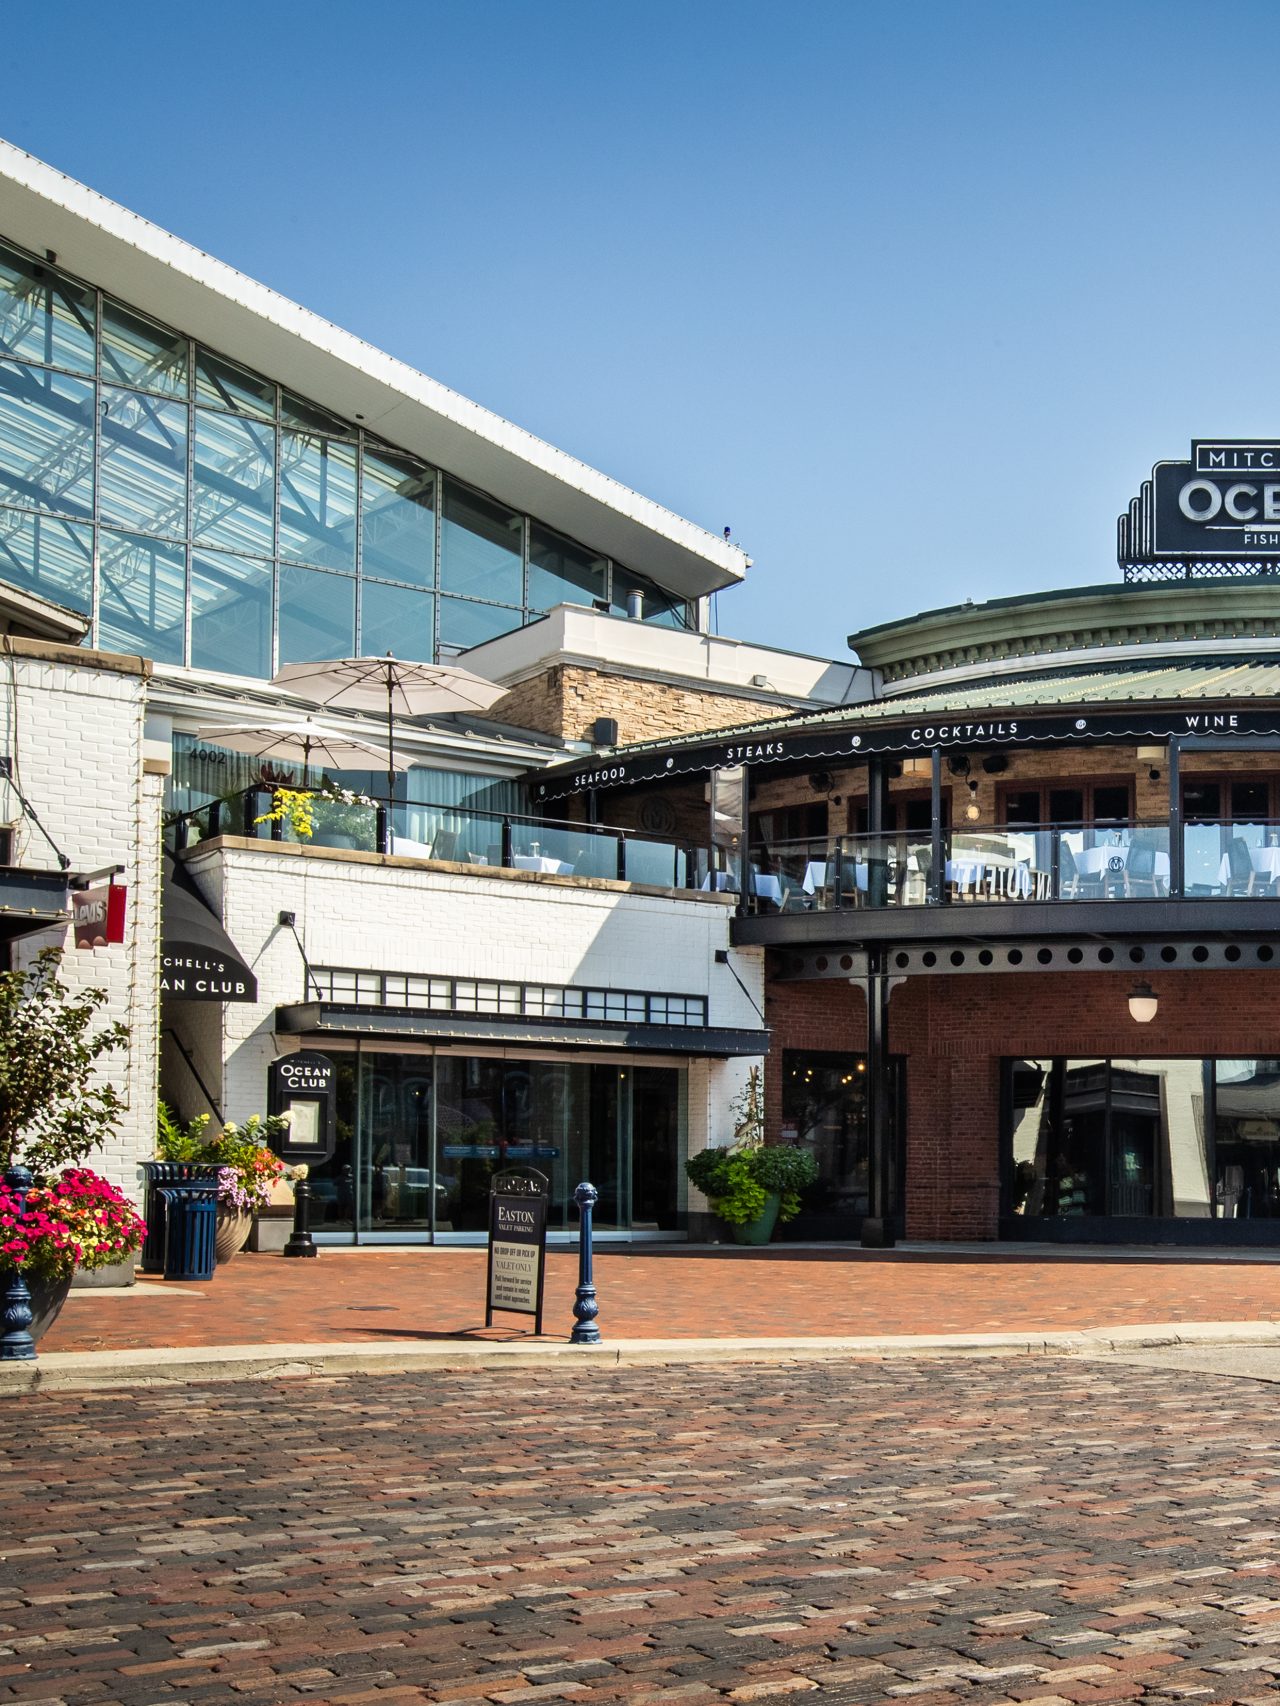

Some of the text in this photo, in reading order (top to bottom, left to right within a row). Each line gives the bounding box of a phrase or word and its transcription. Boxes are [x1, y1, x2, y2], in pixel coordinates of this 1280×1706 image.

[1244, 534, 1279, 545] FISH
[1185, 715, 1238, 728] WINE
[911, 722, 1018, 740] COCKTAILS
[190, 748, 226, 764] 4002
[726, 742, 783, 759] STEAKS
[574, 767, 625, 786] SEAFOOD
[196, 981, 245, 993] CLUB
[280, 1064, 331, 1077] OCEAN
[287, 1077, 327, 1088] CLUB
[498, 1206, 535, 1223] EASTON
[513, 1225, 534, 1233] PARKING
[522, 1249, 530, 1258] PICK
[530, 1250, 536, 1259] UP
[496, 1261, 532, 1273] VALET ONLY
